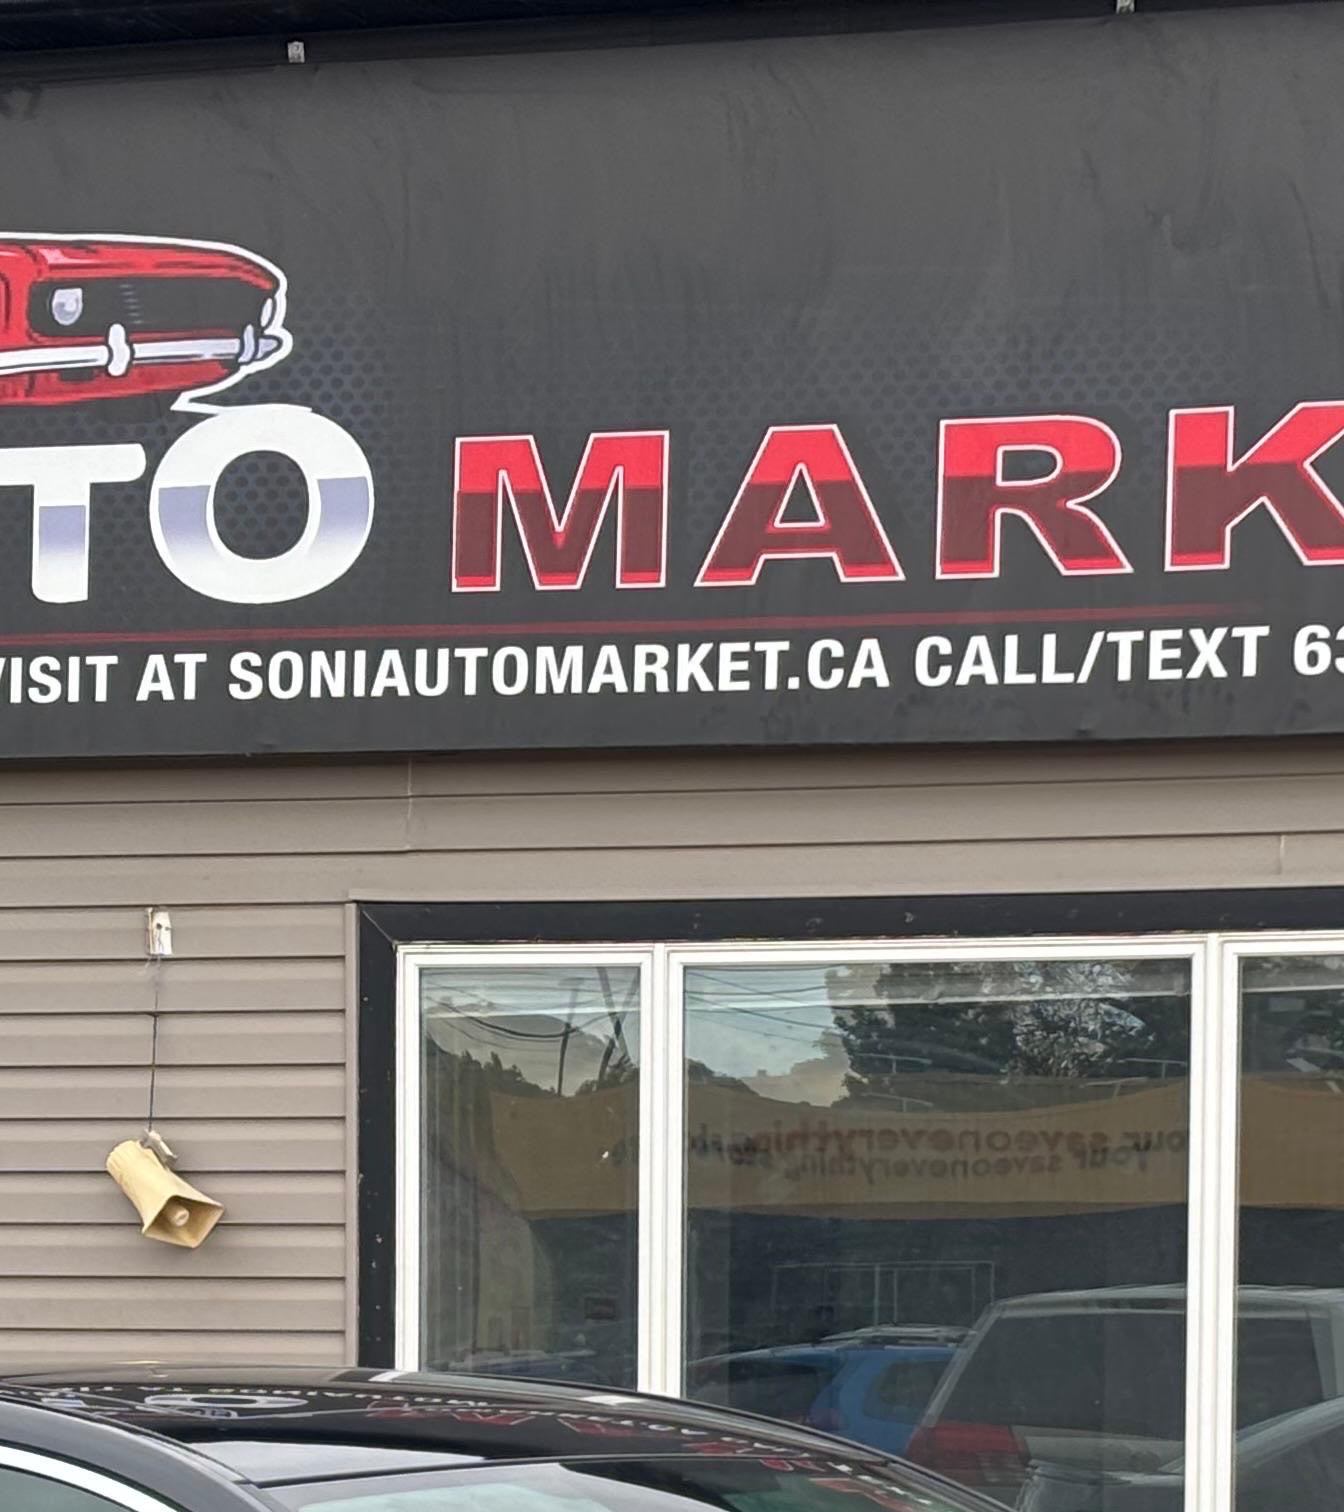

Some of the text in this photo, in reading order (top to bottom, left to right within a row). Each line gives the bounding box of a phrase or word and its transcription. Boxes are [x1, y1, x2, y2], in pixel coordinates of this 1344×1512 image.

[136, 652, 207, 702] AT
[228, 638, 889, 700] SONIAUTOMARKET.CA
[915, 625, 1269, 687] CALL/TEXT
